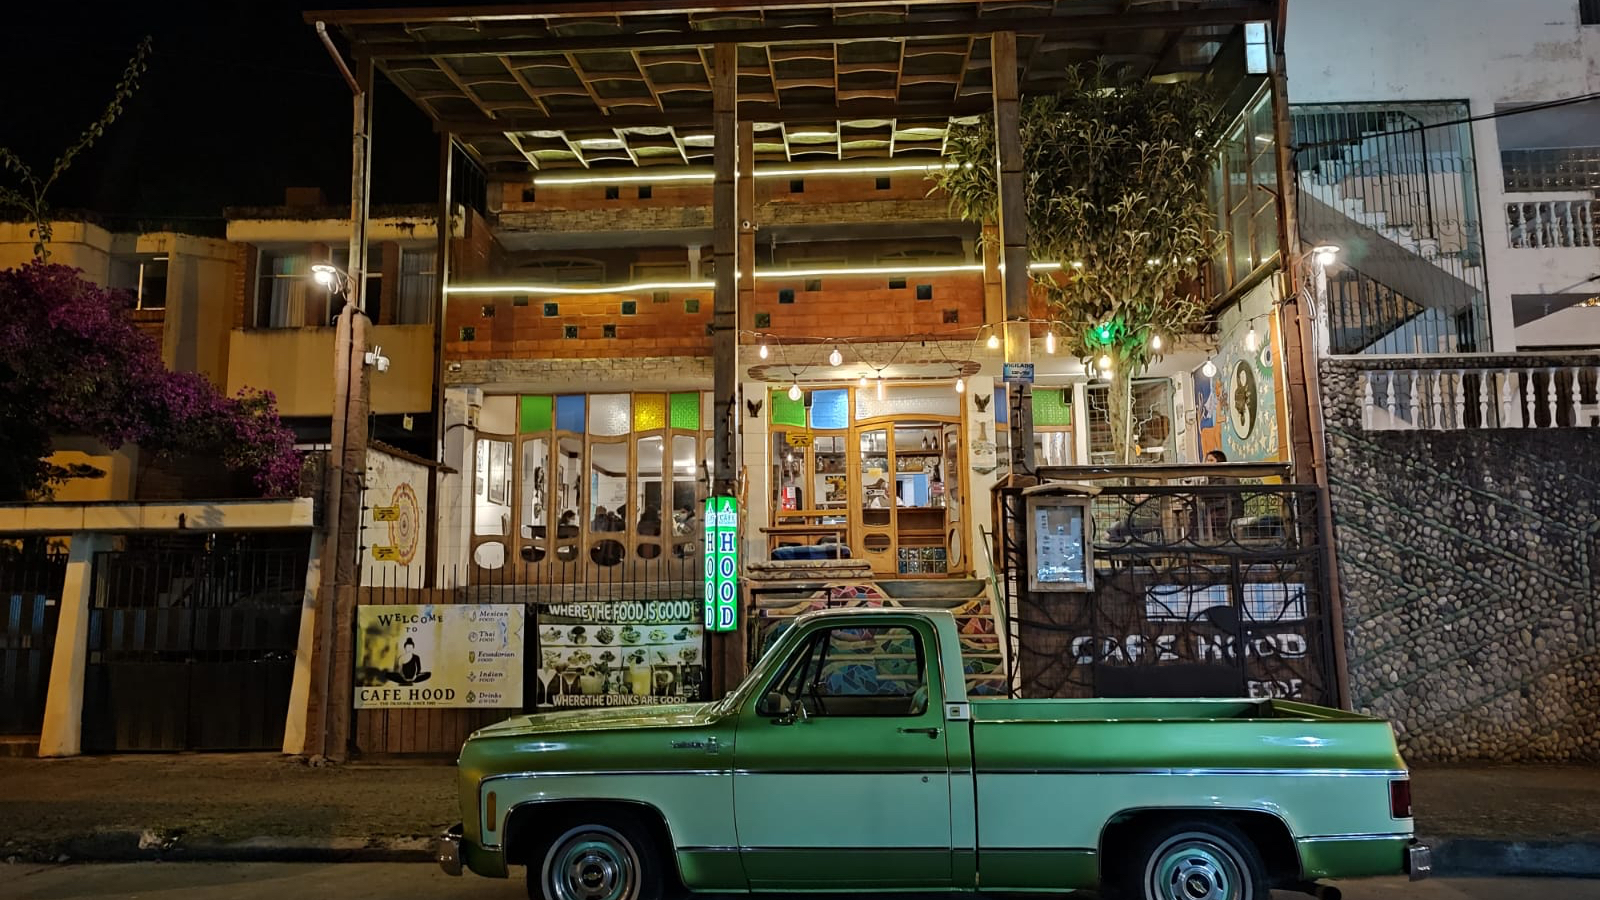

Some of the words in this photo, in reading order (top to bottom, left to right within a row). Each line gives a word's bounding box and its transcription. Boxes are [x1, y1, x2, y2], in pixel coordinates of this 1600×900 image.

[721, 533, 734, 625] HOOD
[549, 604, 588, 618] WHERE
[590, 605, 612, 620] THE
[614, 603, 643, 620] FOOD
[646, 603, 656, 619] IS
[658, 601, 691, 619] GOOD
[377, 613, 444, 627] WELCOME
[1072, 634, 1179, 665] CAFE
[361, 689, 402, 701] CAFE
[409, 688, 455, 700] HOOD
[552, 695, 586, 707] WHERE
[587, 695, 605, 706] THE
[606, 694, 640, 706] DRINKS
[641, 696, 659, 705] ARE
[660, 696, 688, 704] GOOD
